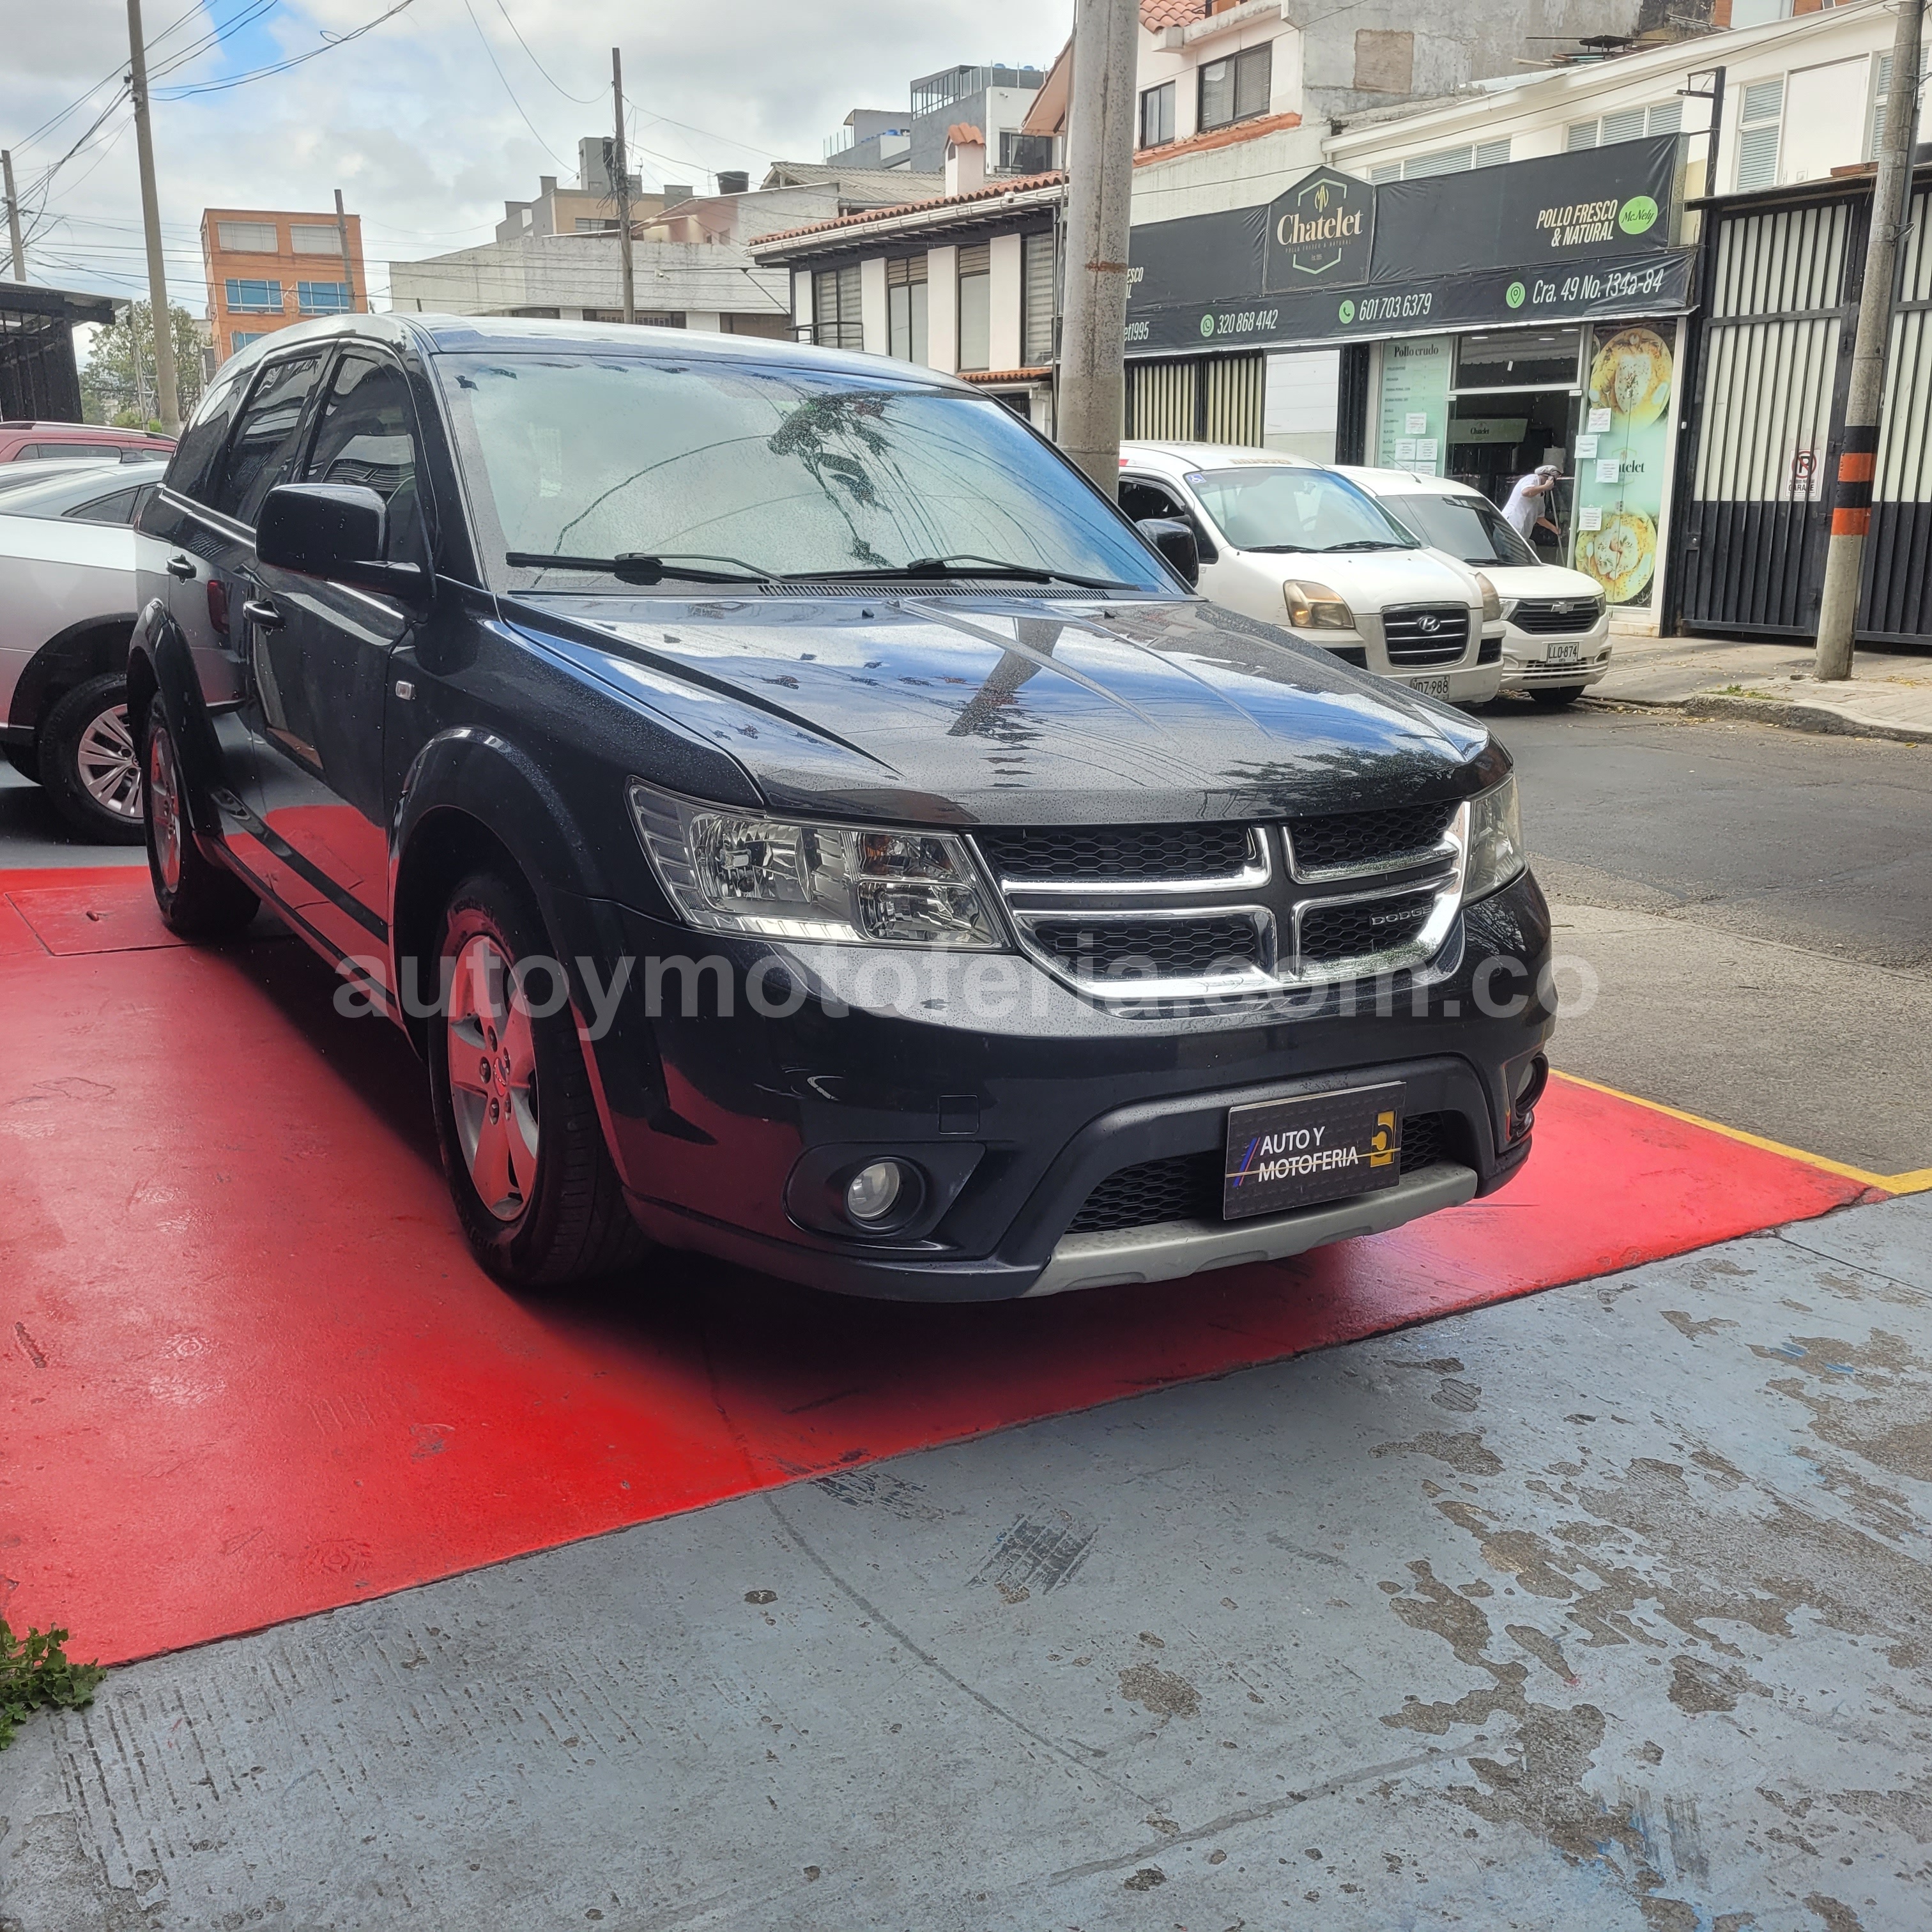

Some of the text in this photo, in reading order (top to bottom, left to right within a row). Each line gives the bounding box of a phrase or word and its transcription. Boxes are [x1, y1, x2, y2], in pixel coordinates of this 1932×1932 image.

[1276, 206, 1364, 245] Chatelet
[1536, 199, 1618, 229] POLLO FRESCO
[1551, 220, 1614, 247] & NATURAL
[1533, 268, 1664, 303] Cra. 49 No. 134a-84
[1217, 309, 1278, 334] 320 868 4142
[1359, 293, 1432, 321] 601 703 6379
[1394, 344, 1439, 358] Pollo crudo
[1372, 905, 1432, 926] DODGE
[1260, 1126, 1325, 1156] AUTO Y
[1258, 1146, 1359, 1183] MOTOFERIA
